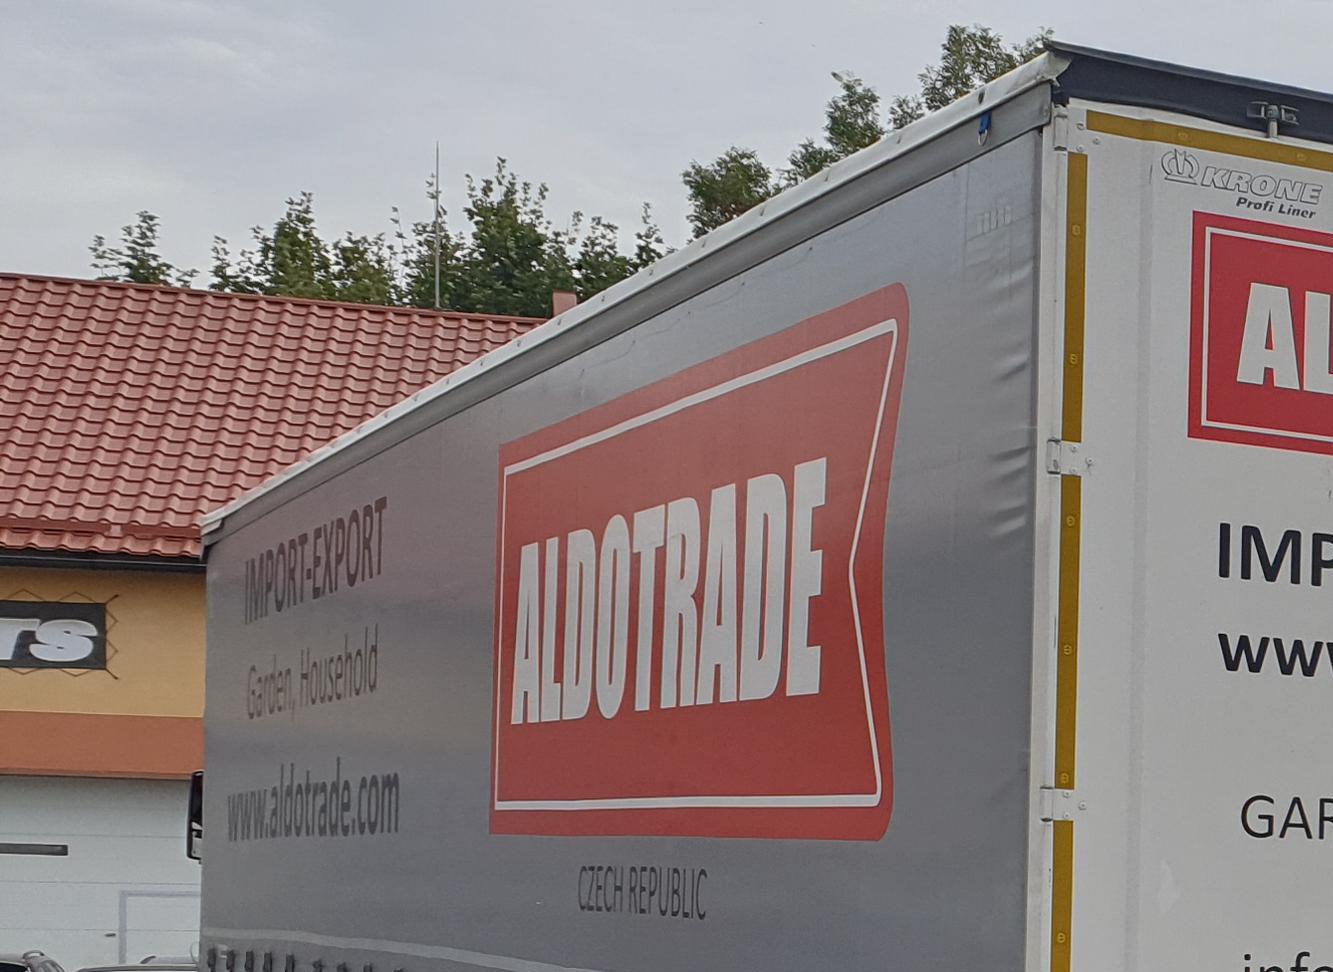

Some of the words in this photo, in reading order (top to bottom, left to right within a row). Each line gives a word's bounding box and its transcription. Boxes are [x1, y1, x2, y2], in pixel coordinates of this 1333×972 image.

[1201, 165, 1323, 205] KRONE
[1236, 197, 1274, 213] Profi
[1279, 203, 1317, 219] Liner
[245, 496, 388, 625] IMPORT-EXPORT
[511, 457, 827, 725] ALDOTRADE
[301, 623, 378, 706] Household
[228, 755, 399, 842] www.aldotrade.com
[578, 865, 623, 914] CZECH
[629, 866, 707, 920] REPUBLIC
